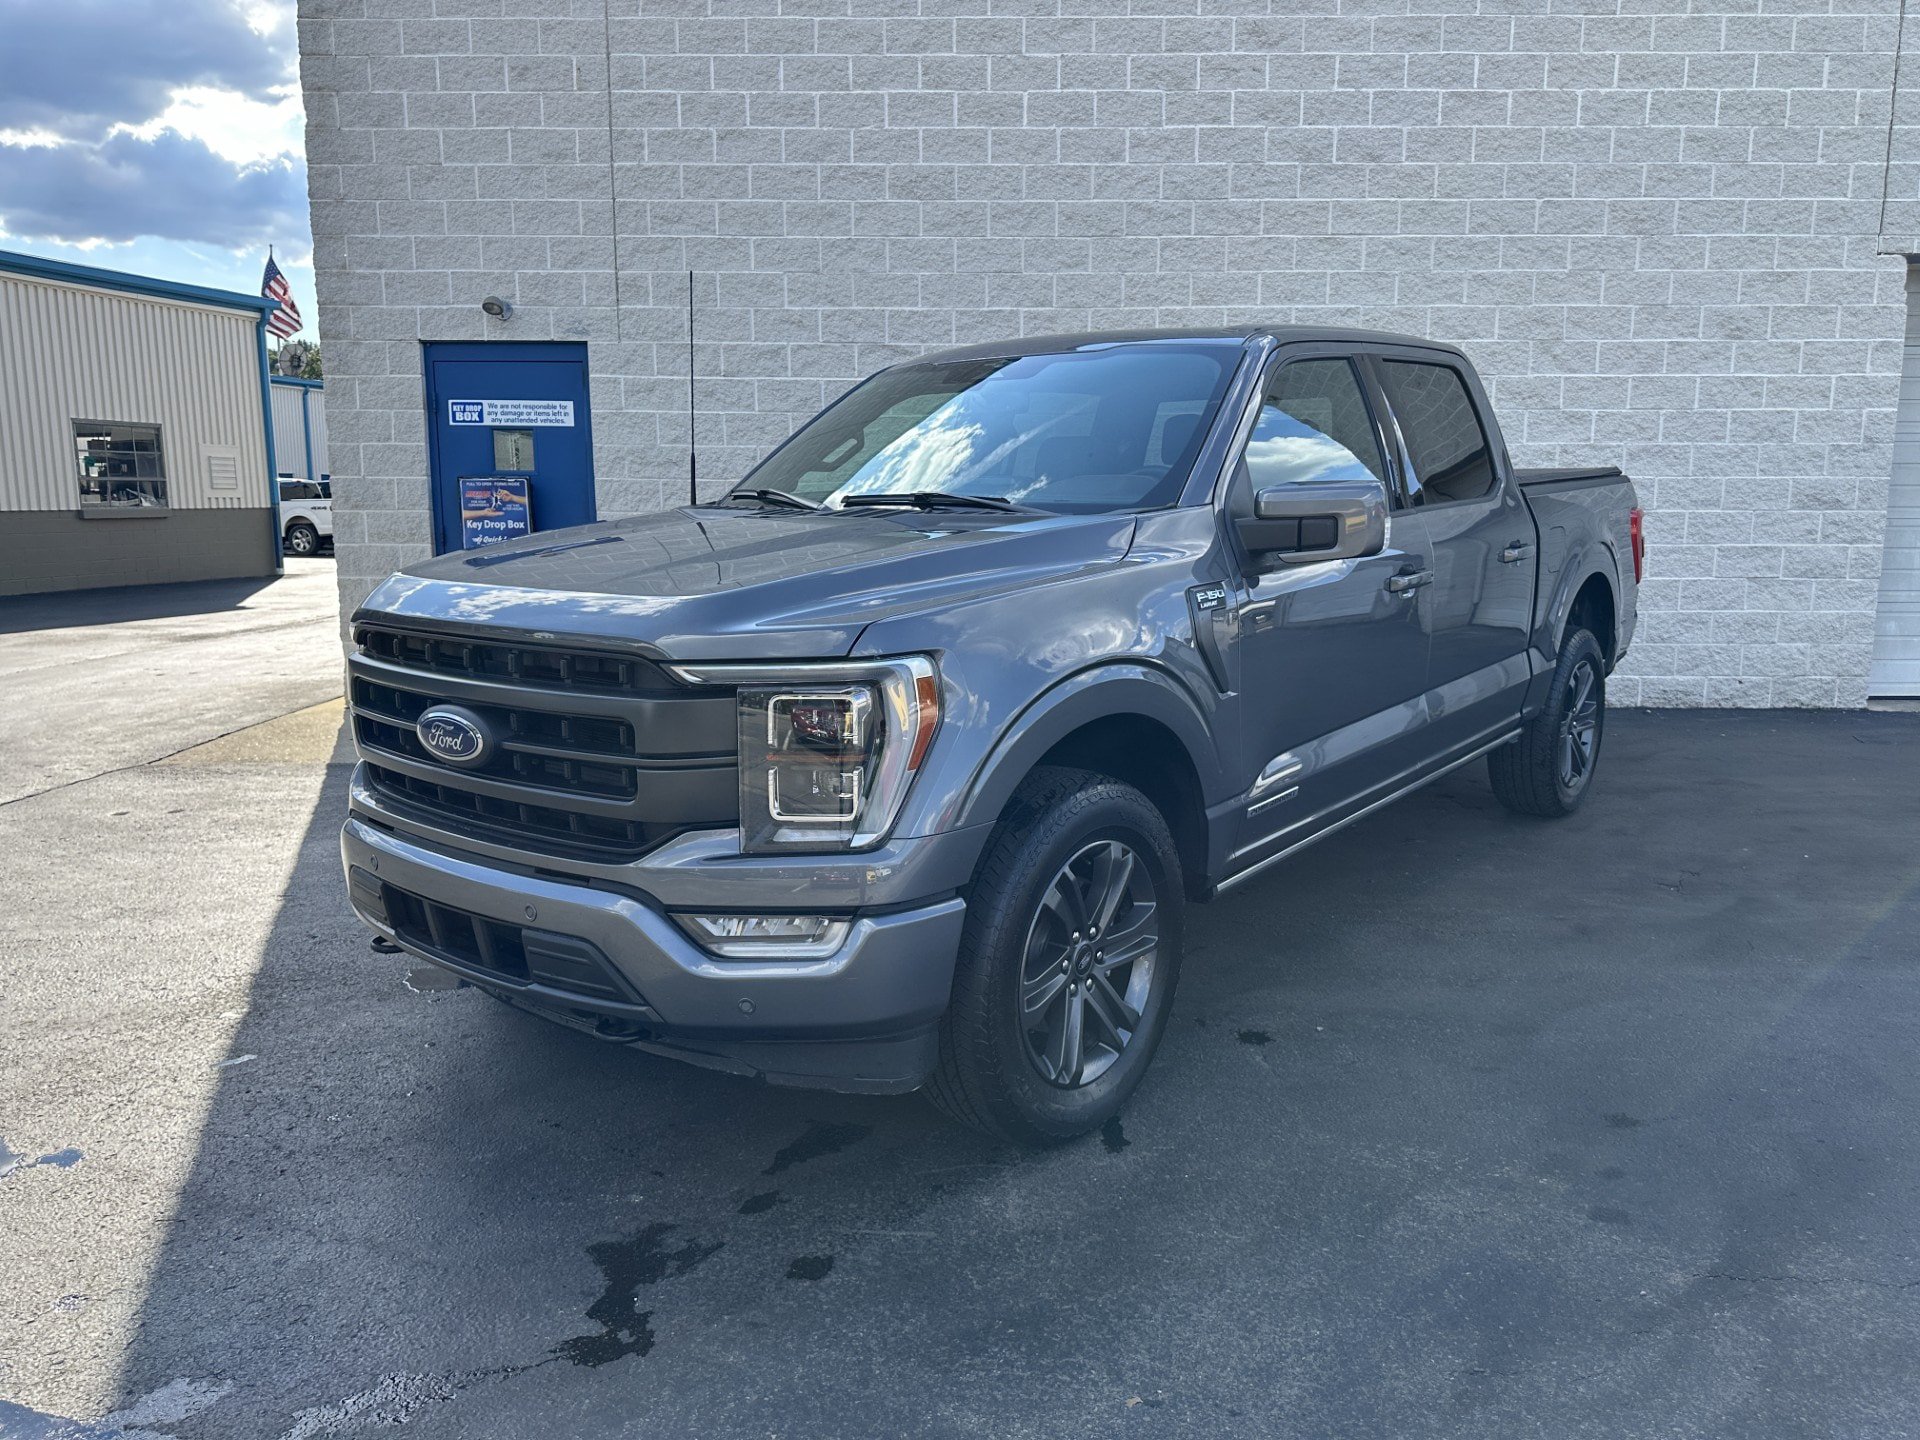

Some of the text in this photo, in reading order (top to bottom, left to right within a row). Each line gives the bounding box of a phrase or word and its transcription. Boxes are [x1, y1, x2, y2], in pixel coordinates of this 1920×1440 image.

[455, 412, 480, 421] BOX
[467, 520, 525, 530] Key Drop Box
[1196, 589, 1225, 602] F-150
[1200, 600, 1218, 608] LARIAT
[428, 721, 463, 751] Ford
